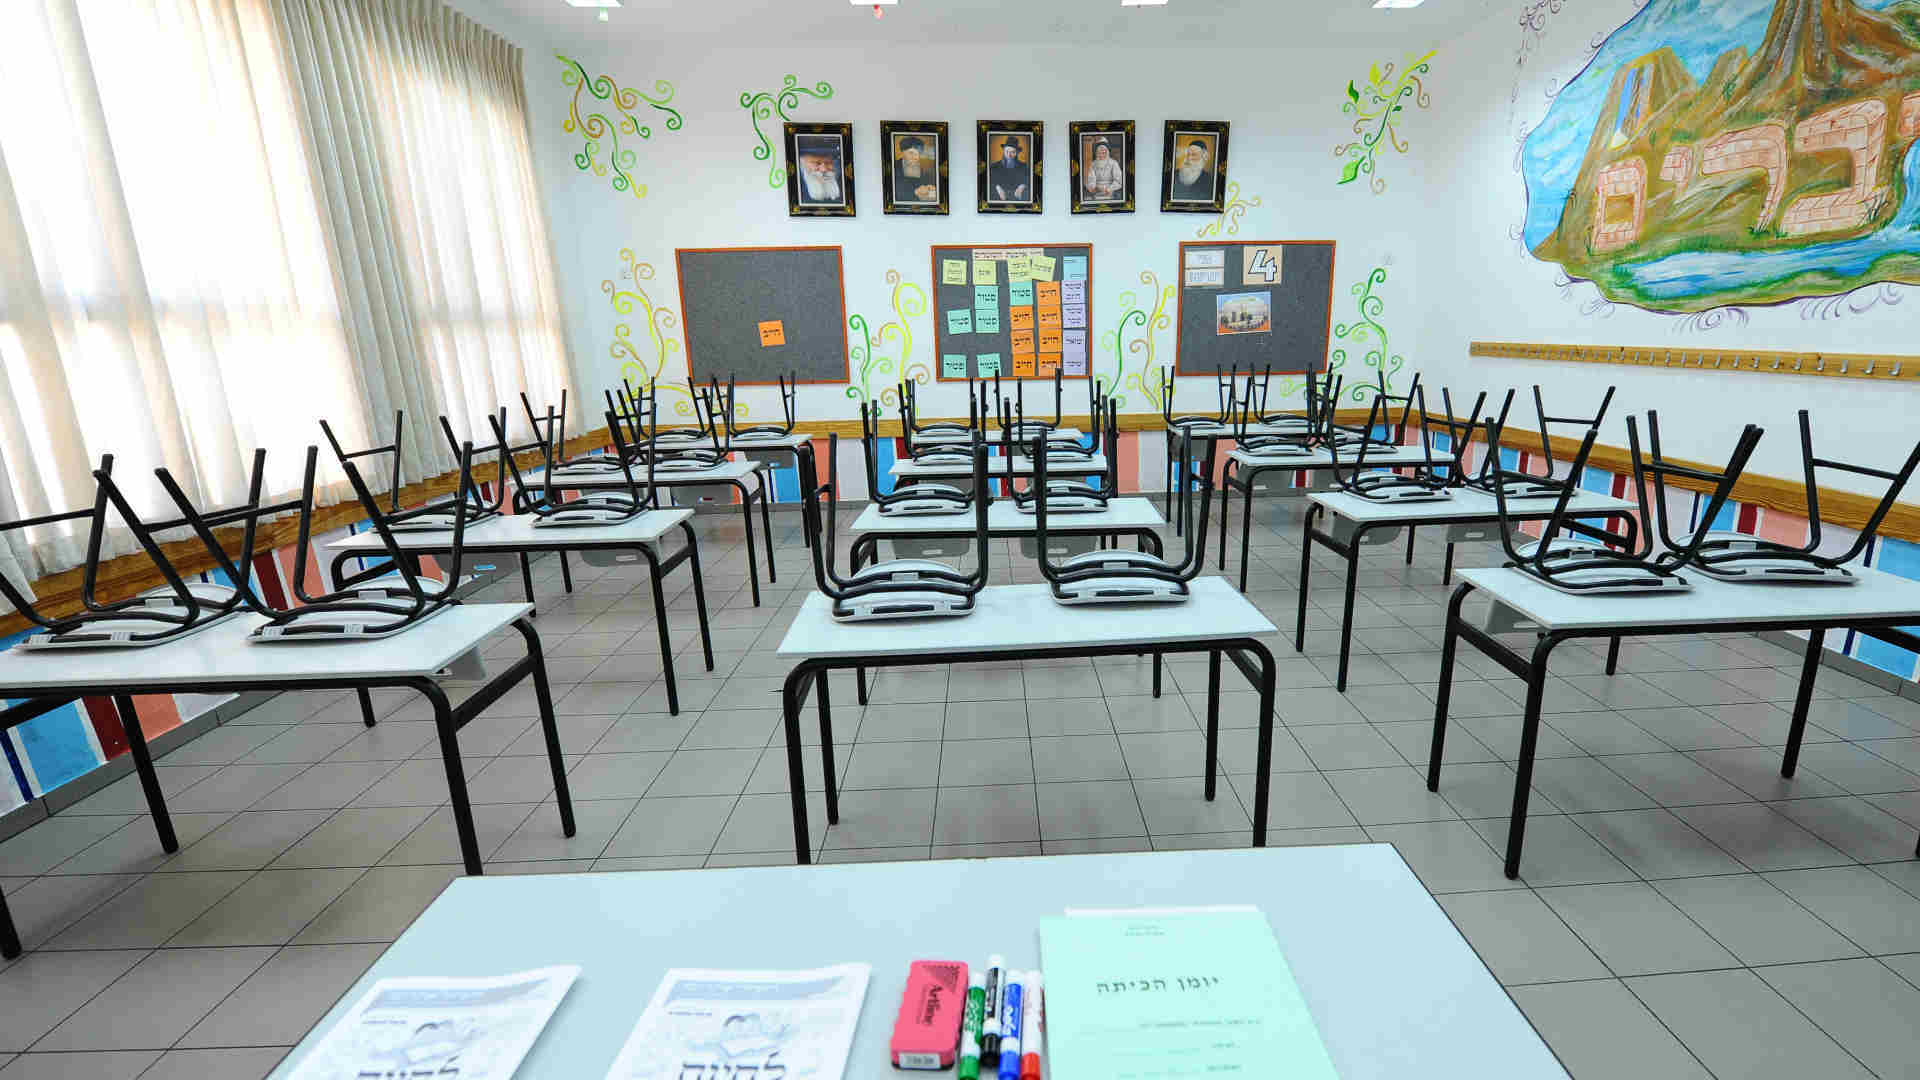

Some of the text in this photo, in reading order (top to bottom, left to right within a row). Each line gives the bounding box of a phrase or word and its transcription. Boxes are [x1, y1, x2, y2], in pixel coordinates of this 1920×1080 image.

[1591, 90, 1920, 256] ברים
[1248, 249, 1277, 282] 4
[1096, 975, 1220, 995] יומן הכיתה
